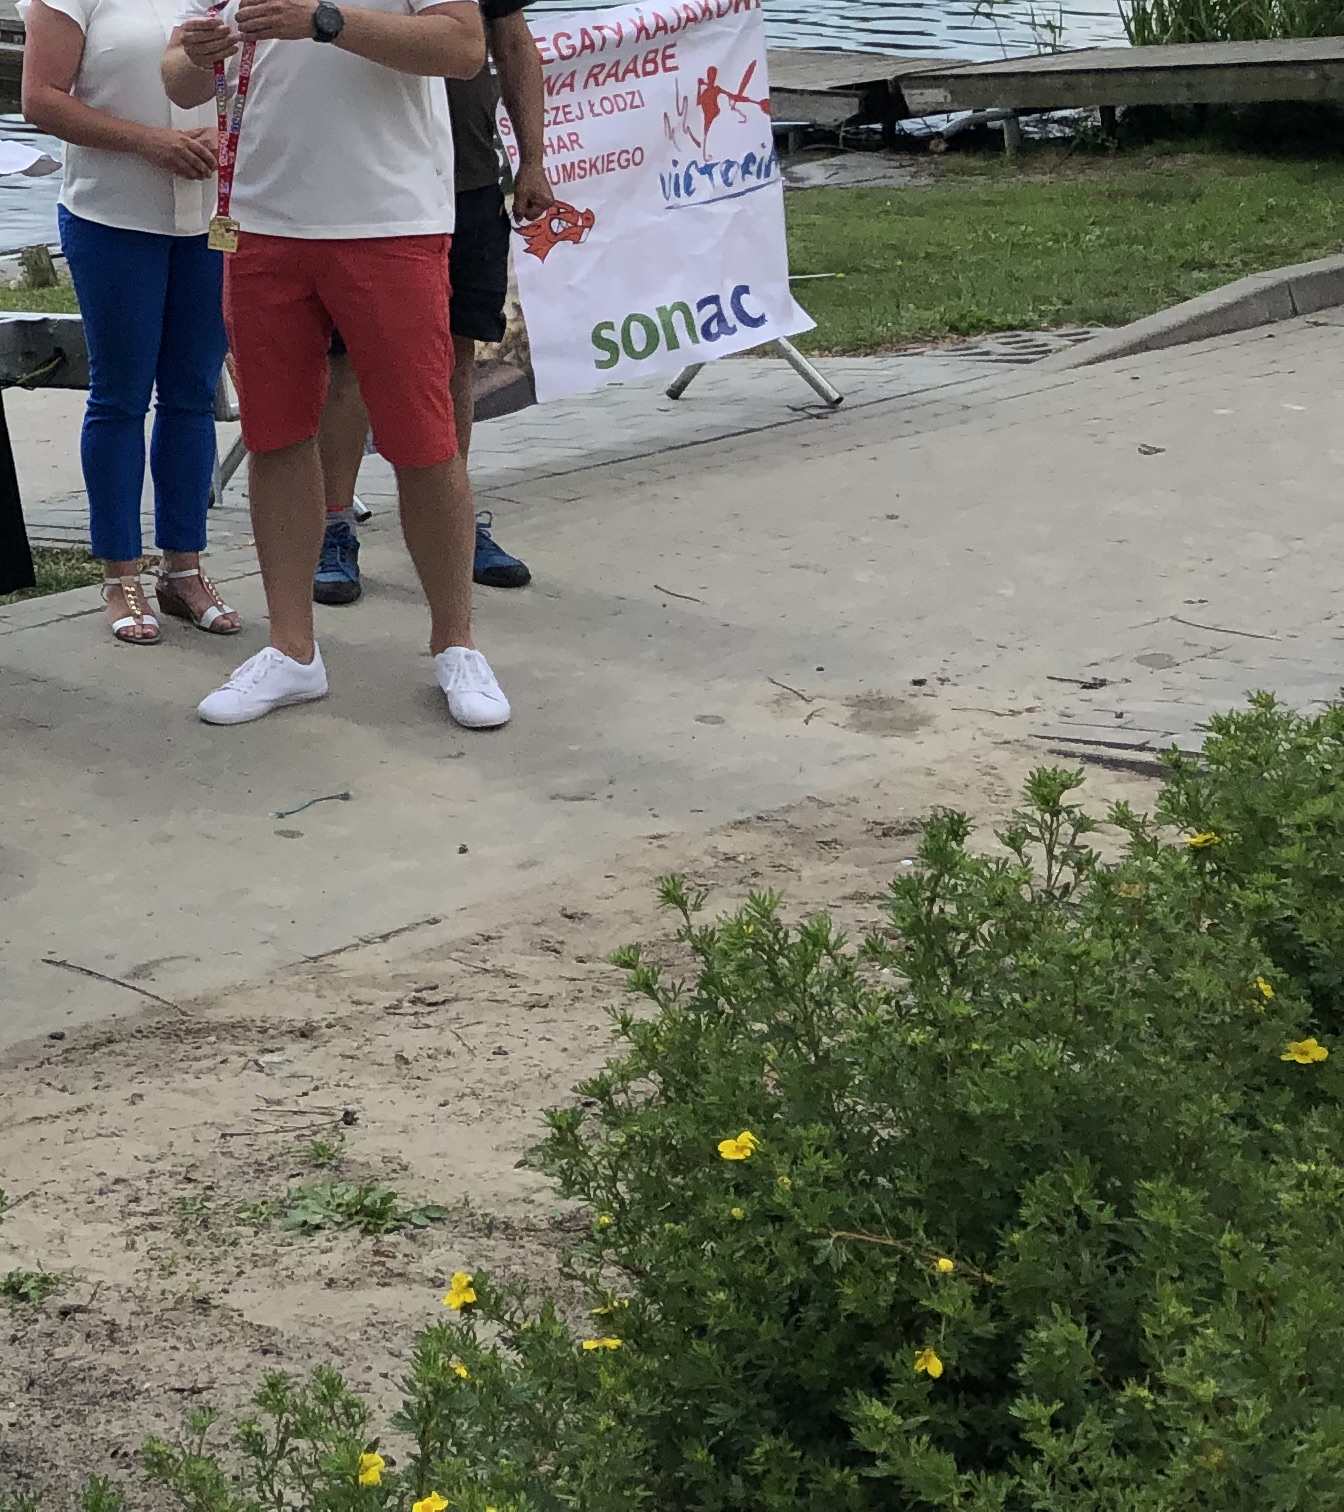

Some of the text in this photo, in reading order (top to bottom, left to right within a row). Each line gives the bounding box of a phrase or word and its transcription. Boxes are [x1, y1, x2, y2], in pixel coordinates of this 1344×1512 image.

[533, 21, 623, 66] EGATY
[583, 43, 679, 90] RAABE
[589, 90, 645, 118] ŁODZI
[591, 285, 767, 369] sonac
